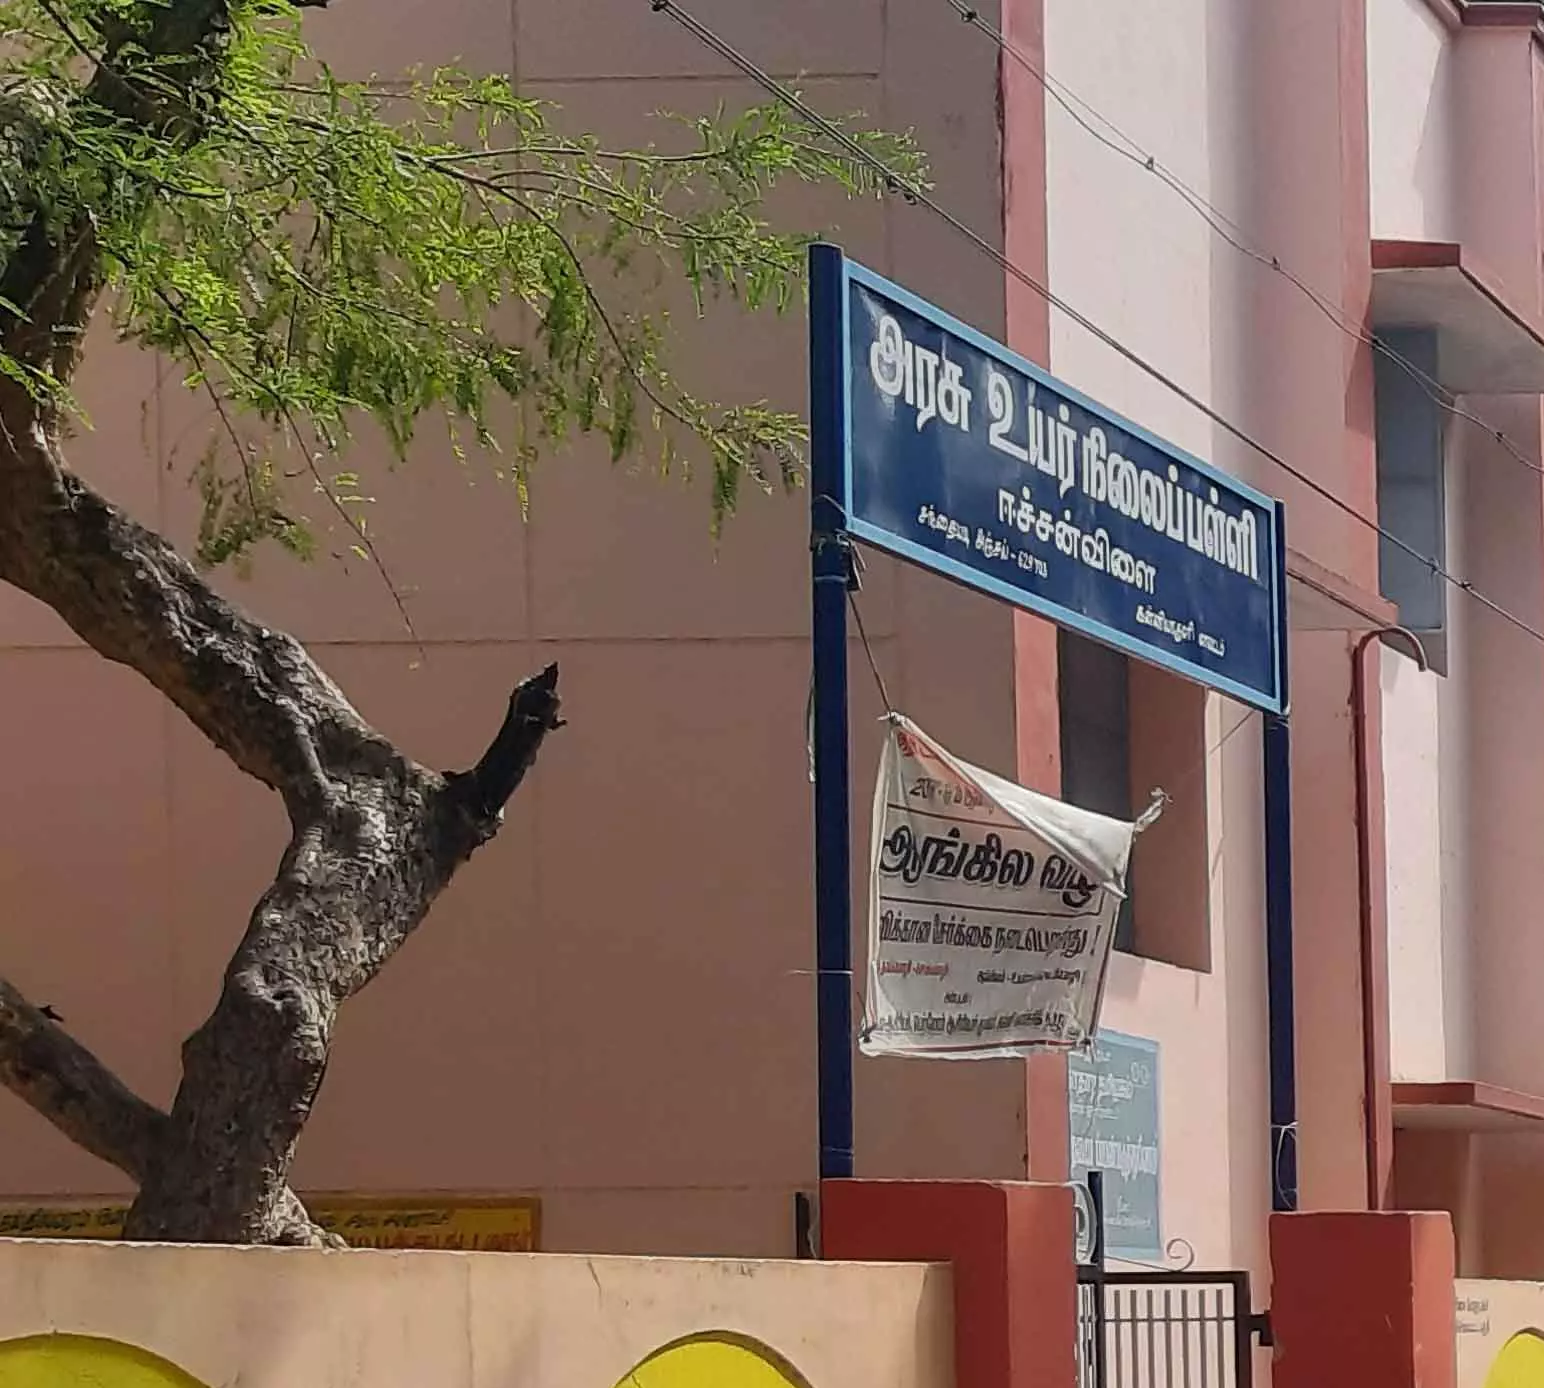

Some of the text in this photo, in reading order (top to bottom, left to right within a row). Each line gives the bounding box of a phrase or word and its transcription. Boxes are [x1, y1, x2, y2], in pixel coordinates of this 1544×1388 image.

[871, 315, 1259, 581] அரசு உயர் நிலைப்பள்ளி
[998, 486, 1157, 594] ஈச்சன்விளை
[879, 825, 1035, 884] ஆங்கில
